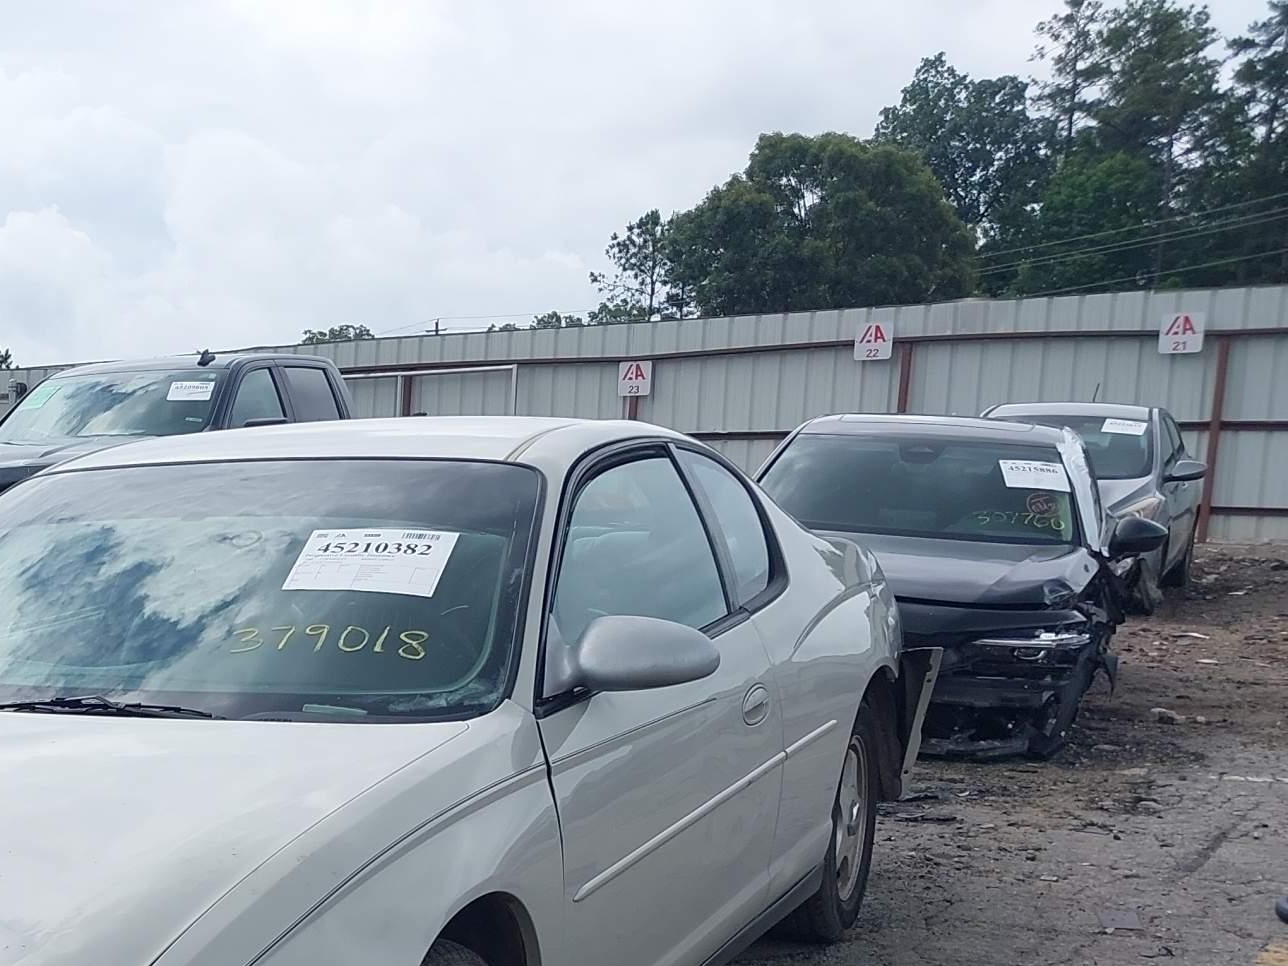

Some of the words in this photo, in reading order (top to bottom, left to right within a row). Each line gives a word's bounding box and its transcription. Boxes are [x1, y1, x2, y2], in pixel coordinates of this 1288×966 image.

[1172, 340, 1187, 351] 21
[865, 348, 880, 358] 22
[627, 385, 640, 394] 23
[317, 542, 433, 556] 45210382
[230, 624, 429, 660] 379018
